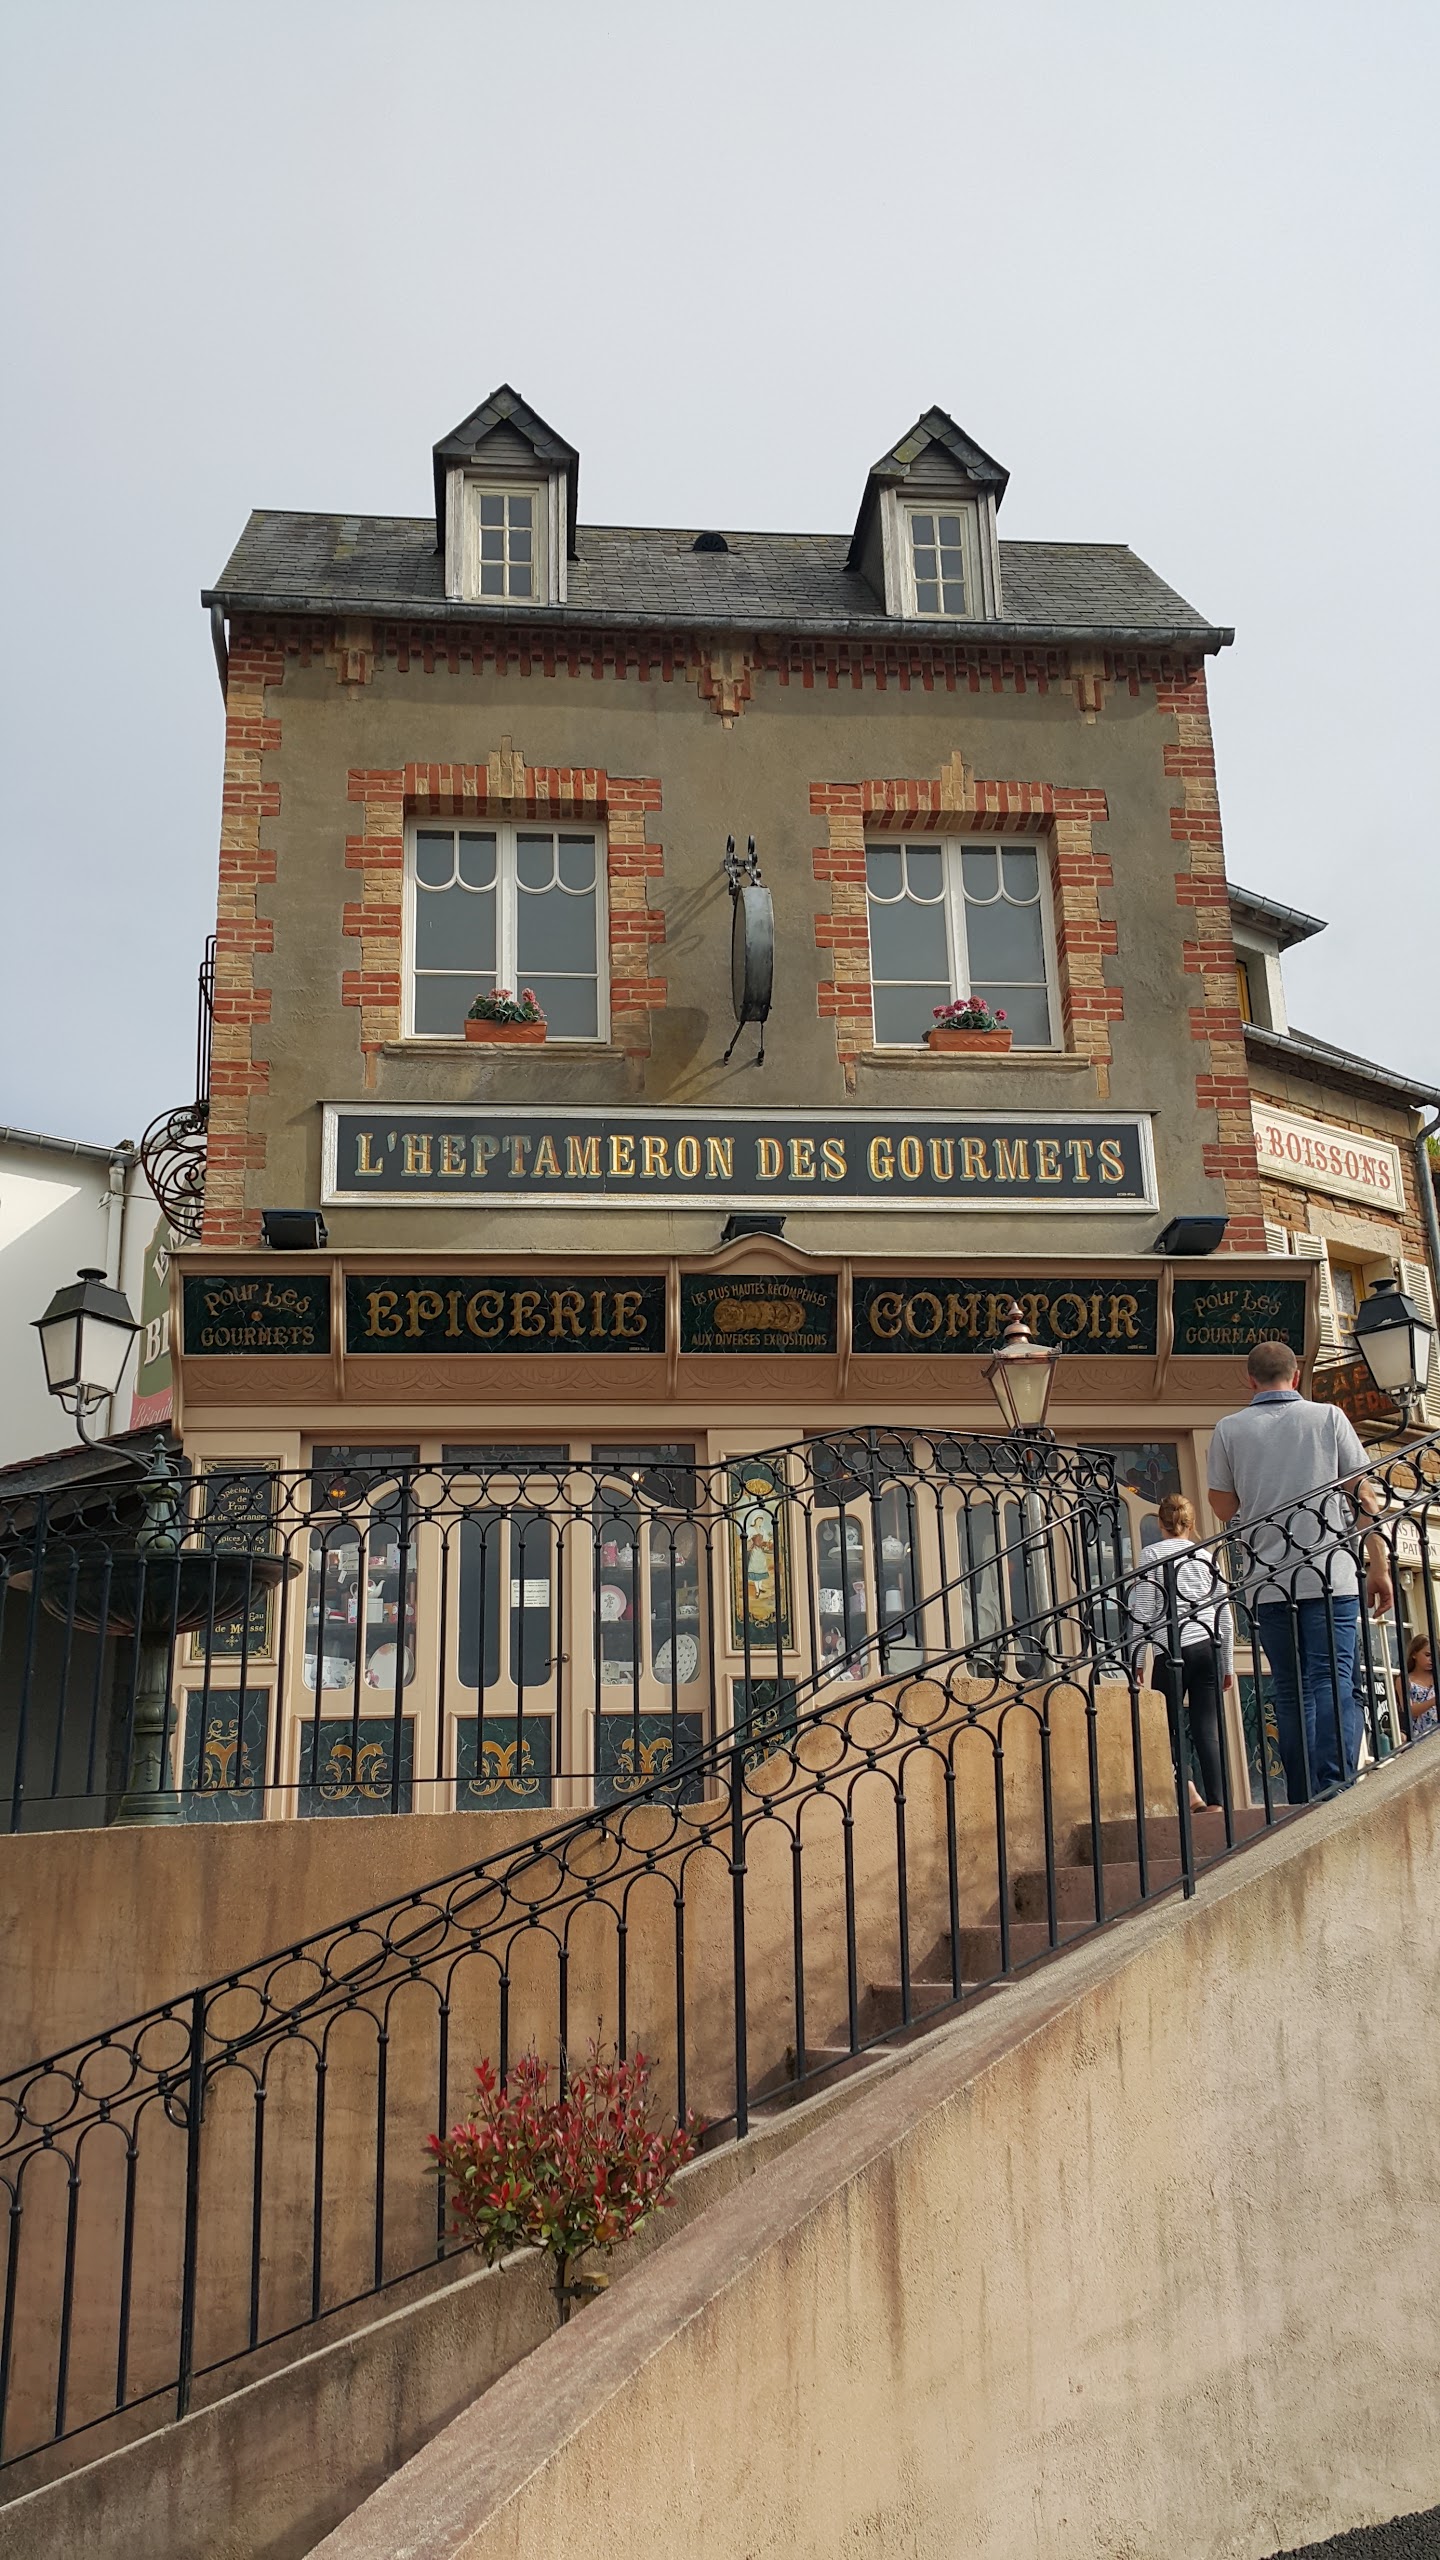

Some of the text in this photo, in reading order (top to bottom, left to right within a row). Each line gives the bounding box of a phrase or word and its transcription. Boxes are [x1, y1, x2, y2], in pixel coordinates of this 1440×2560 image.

[355, 1132, 1126, 1183] L'HEPTAMERON DES GOURMETS
[1266, 1125, 1391, 1190] BOISSONS
[691, 1292, 707, 1306] LES
[708, 1287, 730, 1300] PLUS
[732, 1283, 765, 1297] HAUTES
[365, 1289, 648, 1339] EPICERIE
[869, 1291, 1140, 1339] COMPTOIR
[201, 1326, 315, 1347] GOURMETS
[691, 1334, 828, 1346] AUX DIVERSES EXPOSITIONS
[1186, 1326, 1290, 1344] GOURMANDS
[1312, 1364, 1370, 1398] CAF
